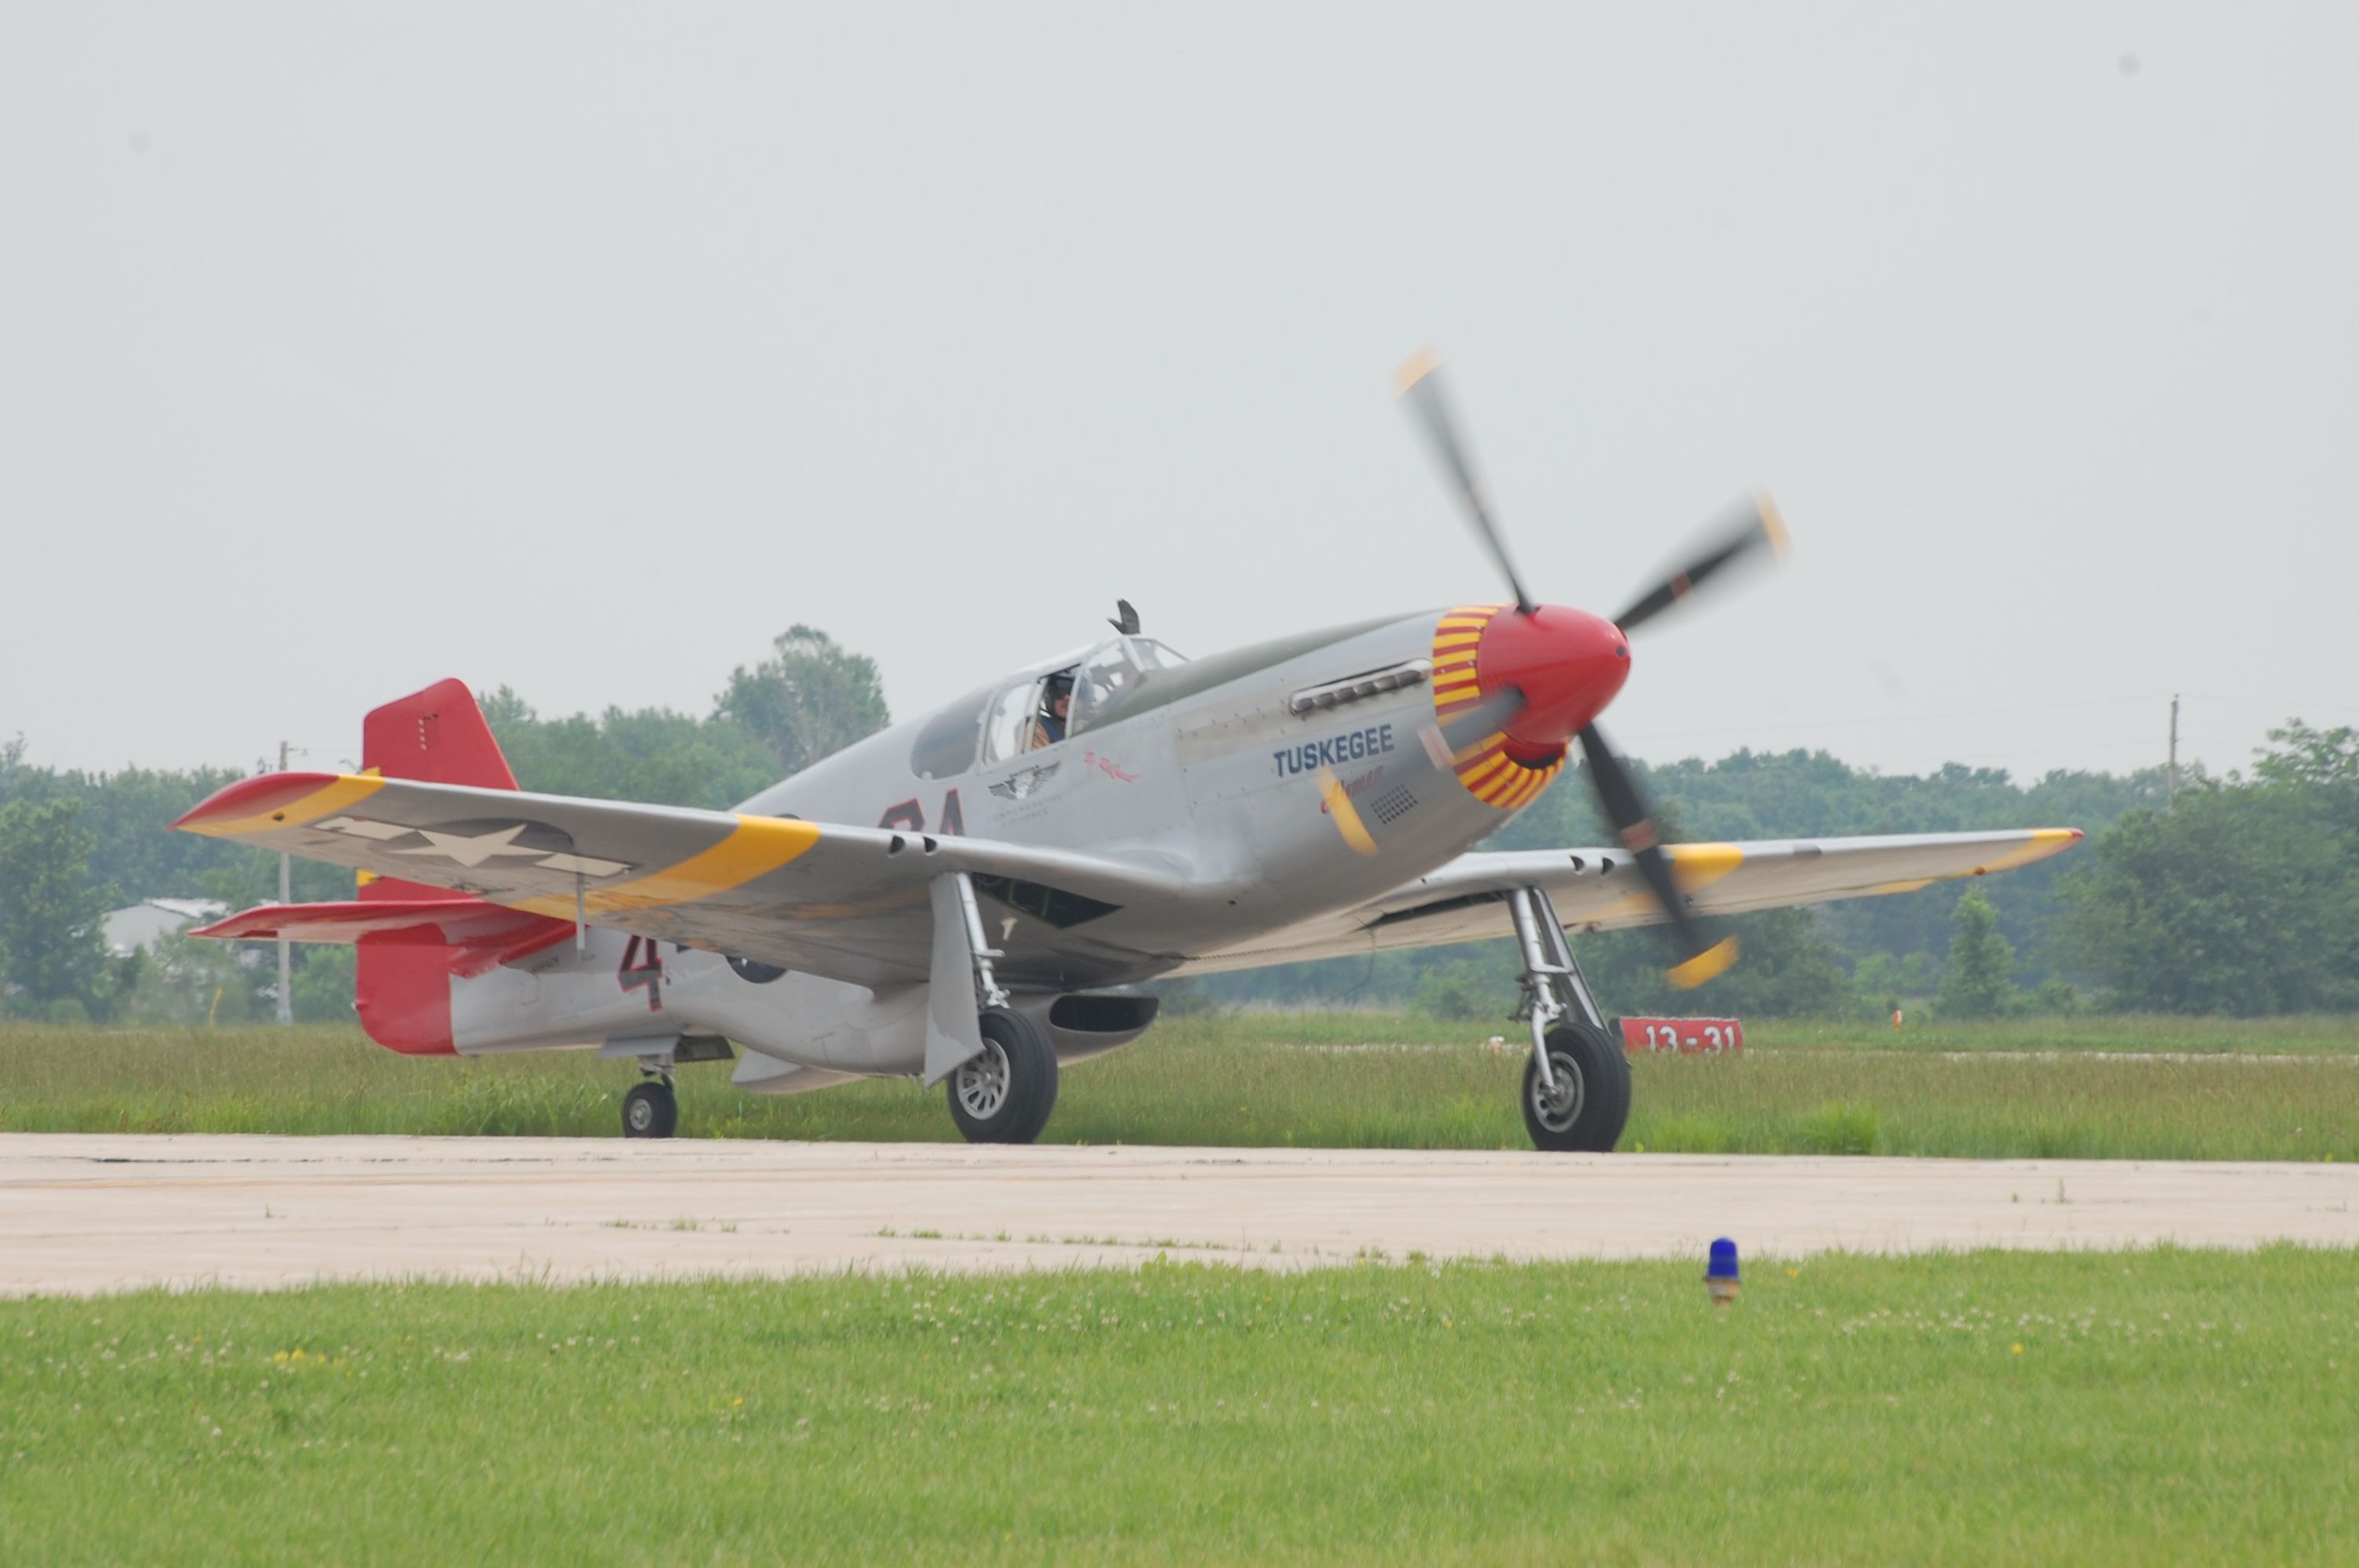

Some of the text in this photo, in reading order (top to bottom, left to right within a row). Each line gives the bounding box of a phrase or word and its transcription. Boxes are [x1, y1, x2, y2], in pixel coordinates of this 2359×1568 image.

[1274, 724, 1394, 777] TUSKEGEE
[617, 934, 663, 1012] 4
[1645, 1025, 1736, 1054] 13-31
